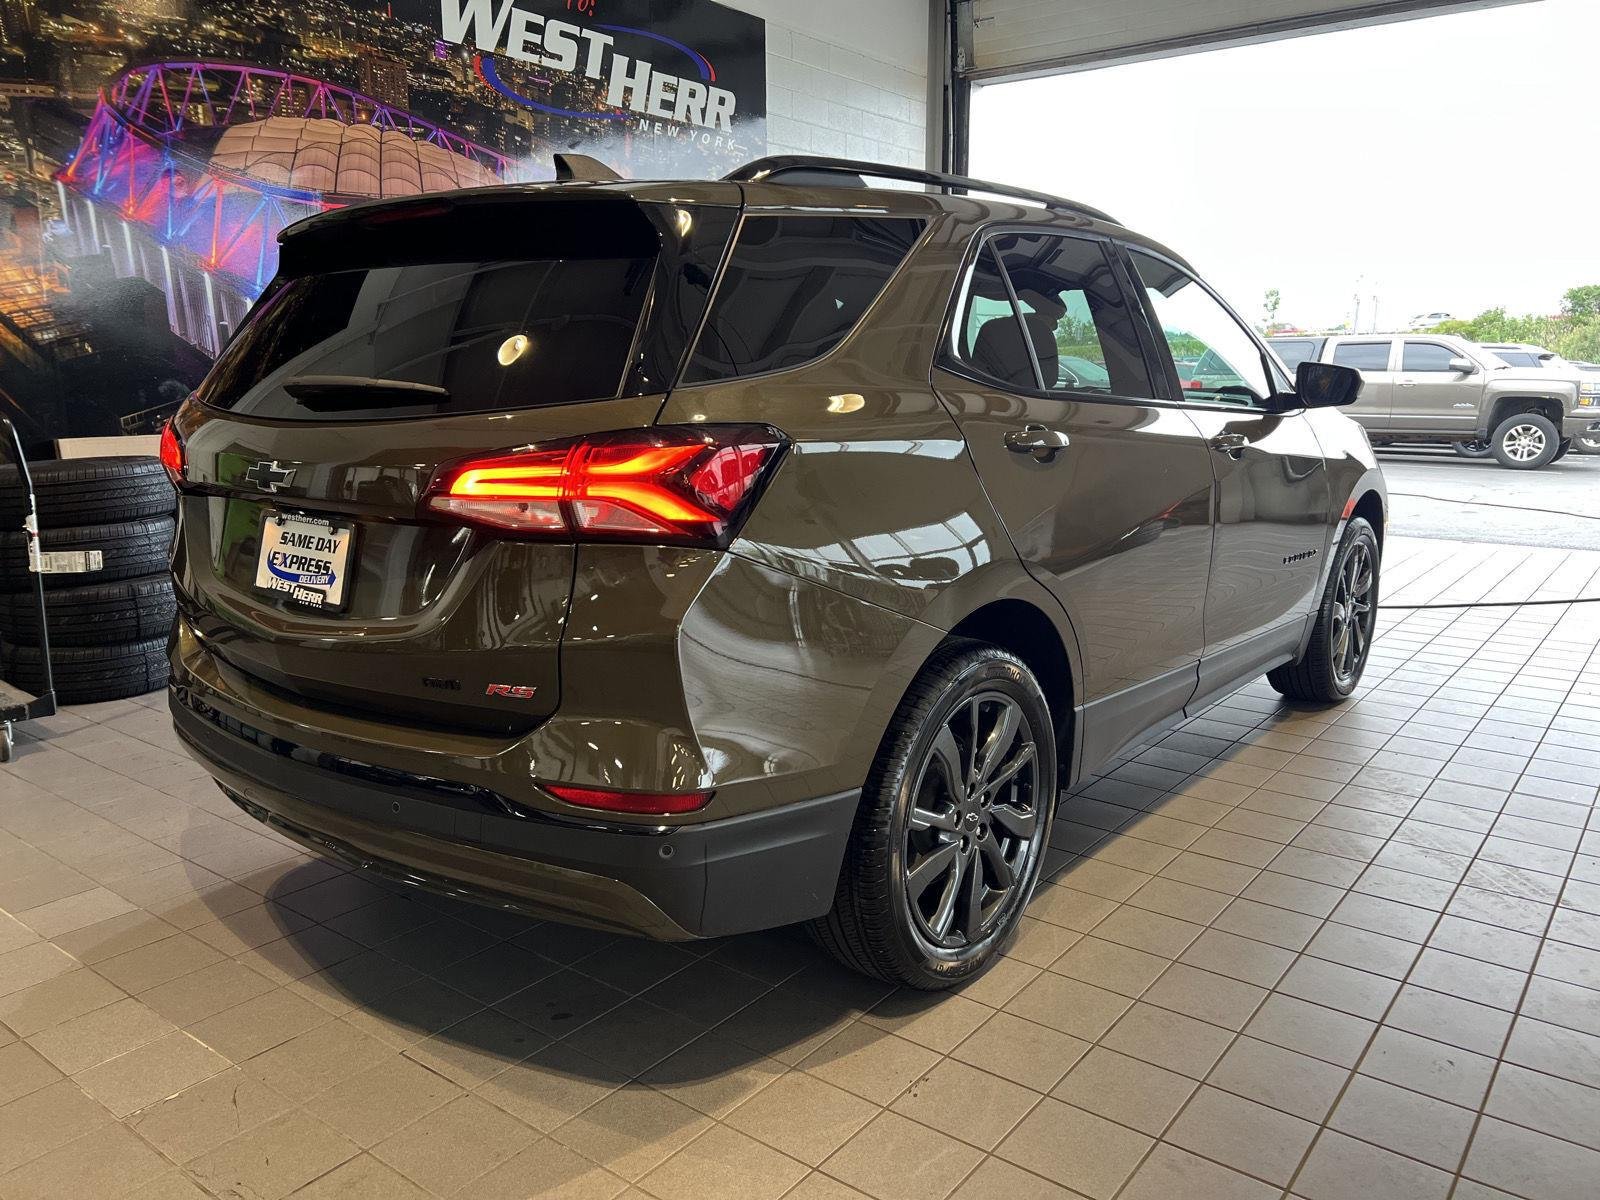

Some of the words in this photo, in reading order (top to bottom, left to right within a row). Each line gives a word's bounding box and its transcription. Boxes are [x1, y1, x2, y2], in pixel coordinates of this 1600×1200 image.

[441, 0, 614, 80] WEST
[606, 53, 737, 134] HERR
[639, 118, 680, 138] NEW
[689, 129, 736, 151] YORK
[281, 513, 330, 526] westherr.com
[279, 531, 316, 550] SAME
[315, 537, 341, 554] DAY
[271, 551, 332, 575] EXPRESS
[267, 577, 297, 593] WEST
[293, 587, 324, 605] HERR
[298, 575, 330, 584] DELIVERY
[485, 683, 537, 699] RS
